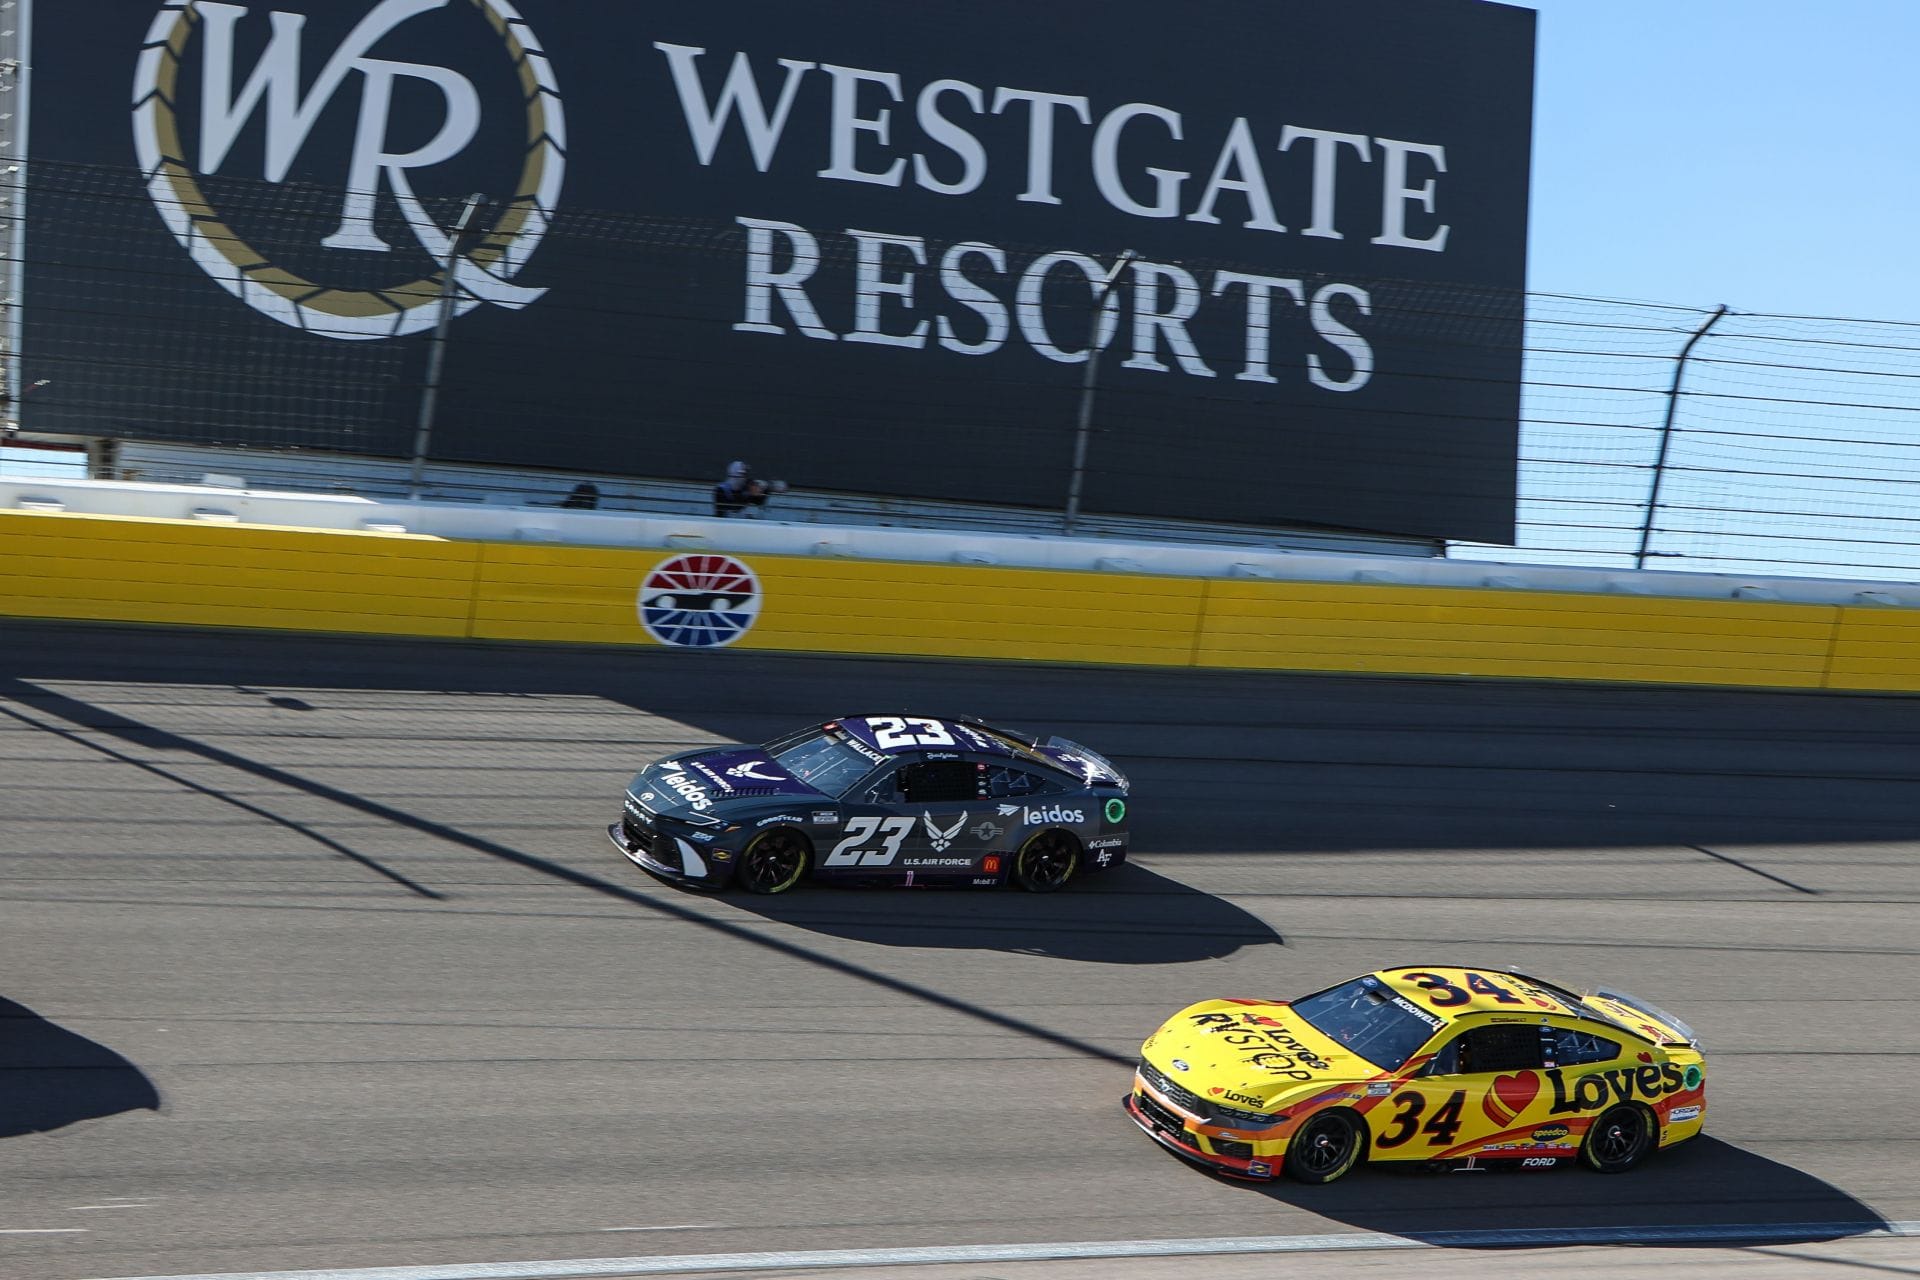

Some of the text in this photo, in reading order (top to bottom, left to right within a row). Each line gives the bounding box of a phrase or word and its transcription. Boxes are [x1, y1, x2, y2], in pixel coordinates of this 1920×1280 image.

[653, 41, 1450, 252] WESTGATE
[731, 216, 1375, 392] RESORTS
[846, 739, 884, 762] WALLACE
[865, 717, 955, 750] 23
[661, 772, 713, 811] leidos
[1023, 805, 1085, 826] leidos
[824, 816, 916, 866] 23
[903, 858, 972, 866] U.S. AIR FORCE
[1402, 973, 1525, 1008] 34
[1376, 1089, 1466, 1150] 34
[1533, 1127, 1568, 1138] speedco
[1522, 1157, 1556, 1167] FORD
